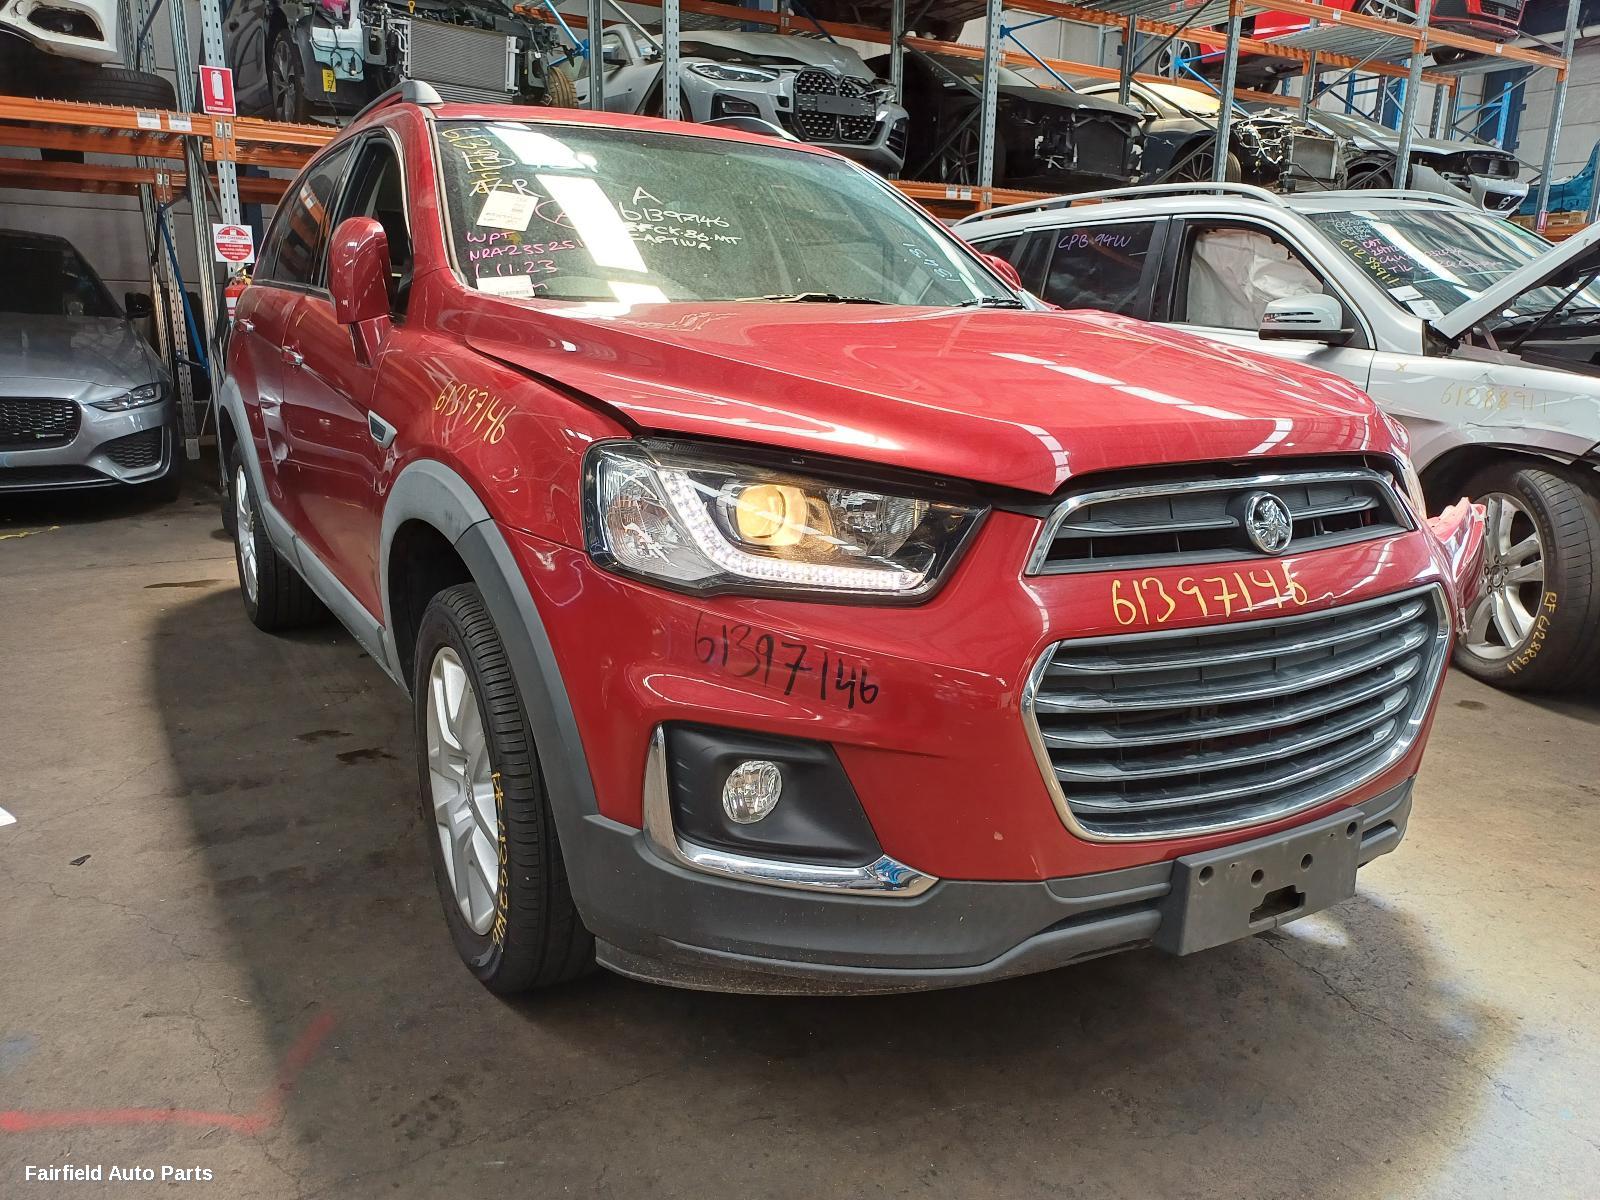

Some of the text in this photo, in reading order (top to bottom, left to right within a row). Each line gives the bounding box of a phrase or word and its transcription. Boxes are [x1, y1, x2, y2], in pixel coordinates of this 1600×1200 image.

[466, 231, 517, 245] WPT
[1111, 560, 1308, 626] 61397146
[694, 610, 879, 710] 61397146
